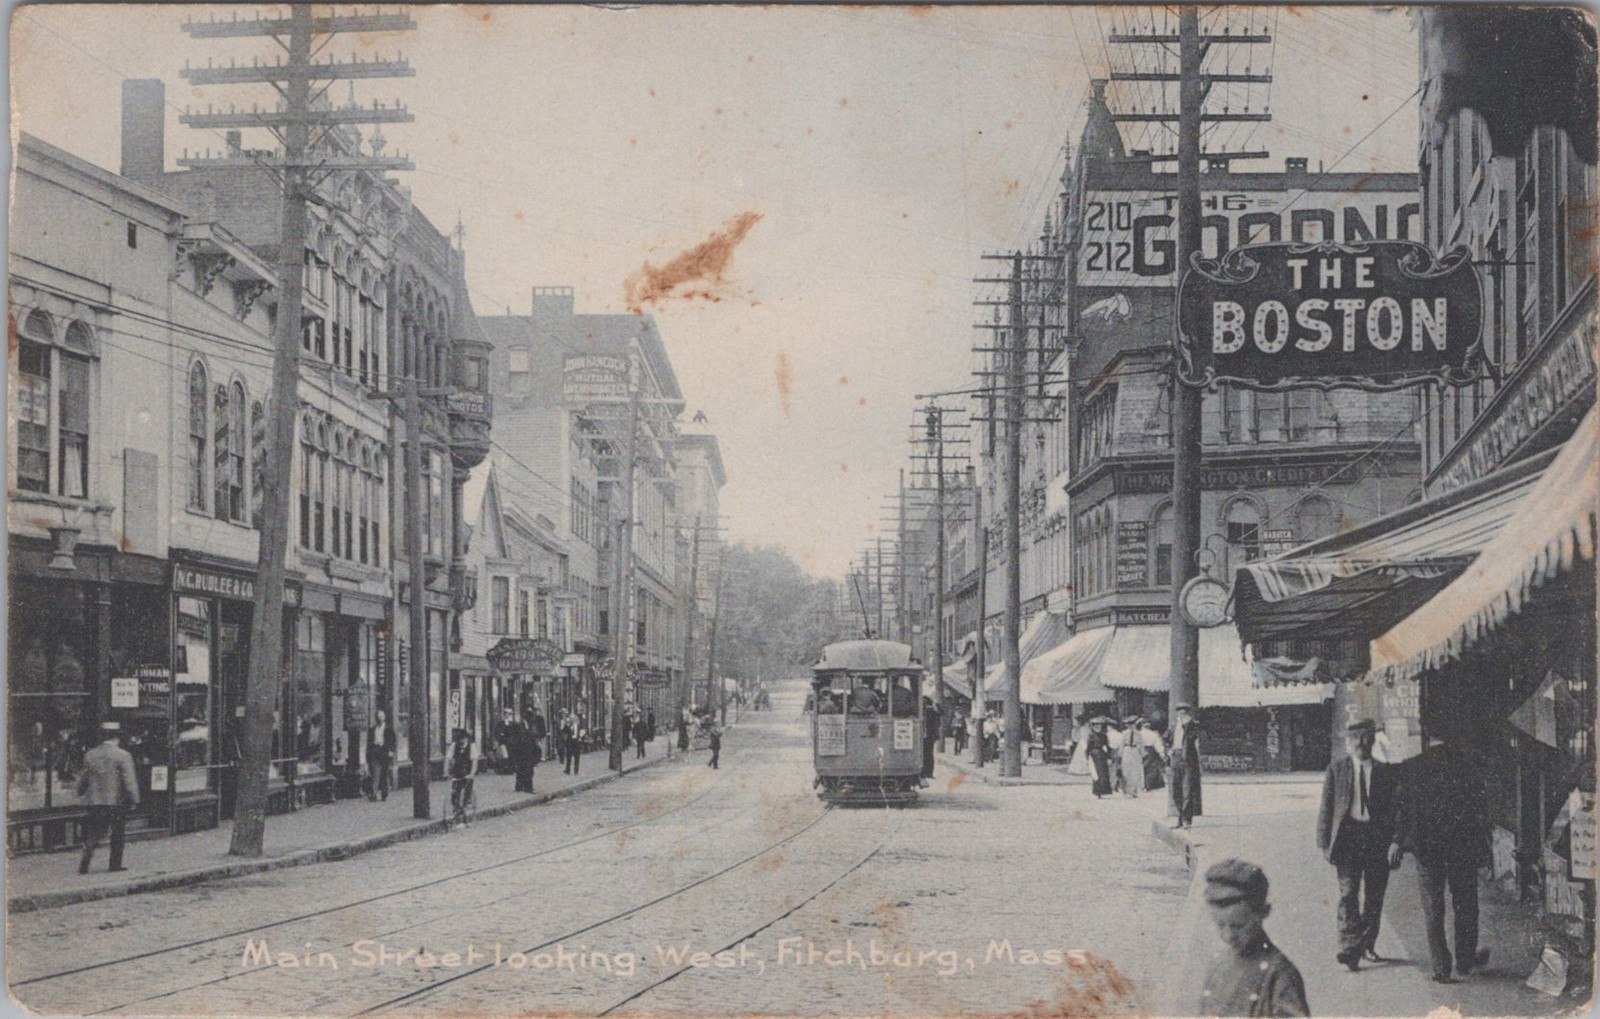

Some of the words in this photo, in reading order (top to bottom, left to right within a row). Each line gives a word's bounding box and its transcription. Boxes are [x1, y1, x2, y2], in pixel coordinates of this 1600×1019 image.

[1088, 202, 1131, 231] 210
[1087, 242, 1131, 271] 212
[1287, 257, 1375, 290] THE
[1212, 297, 1447, 353] BOSTON
